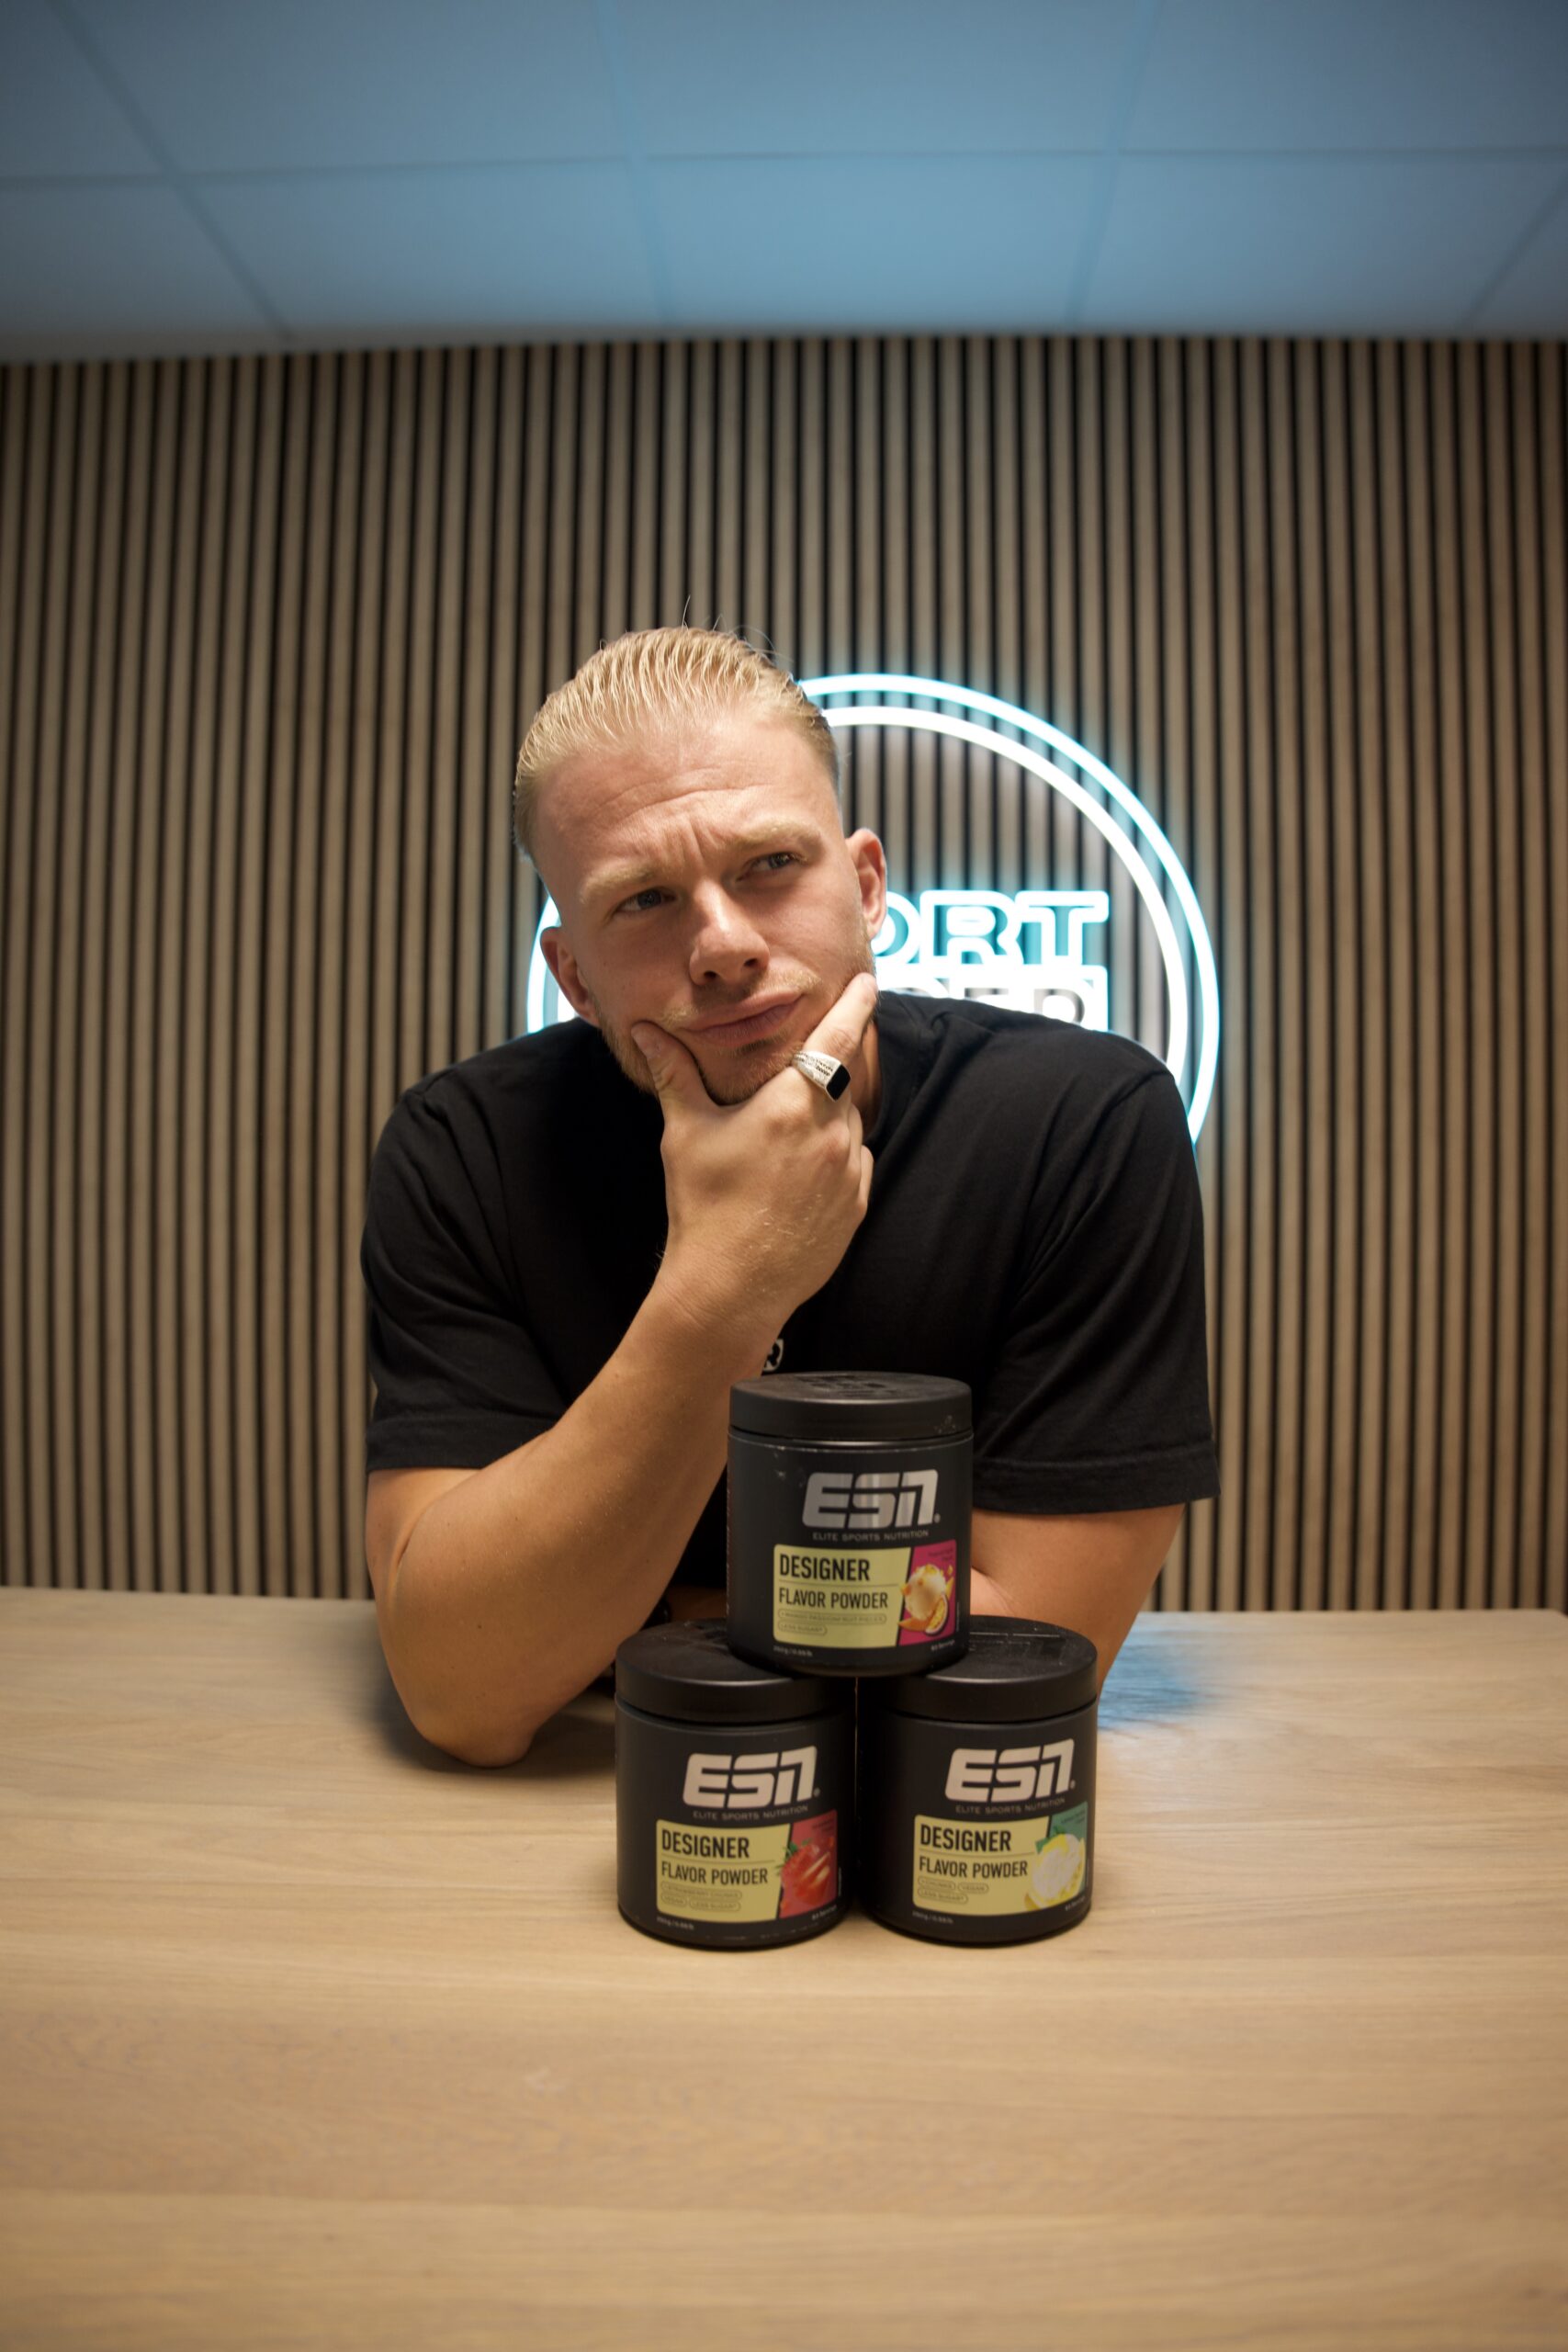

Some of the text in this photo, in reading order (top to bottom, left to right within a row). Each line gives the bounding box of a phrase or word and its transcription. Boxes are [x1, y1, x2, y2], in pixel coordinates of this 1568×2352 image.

[812, 1530, 929, 1542] ELITE SPORTS NUTRITION
[779, 1554, 870, 1581] DESIGNER
[779, 1587, 888, 1610] FLAVOR POWDER
[693, 1805, 808, 1821] ELITE SPORTS NUTRITION
[955, 1797, 1066, 1815] ELITE SPORTS NUTRITION
[661, 1828, 750, 1859] DESIGNER
[920, 1824, 1011, 1852] DESIGNER
[661, 1860, 768, 1885] FLAVOR POWDER
[919, 1856, 1028, 1879] FLAVOR POWDER
